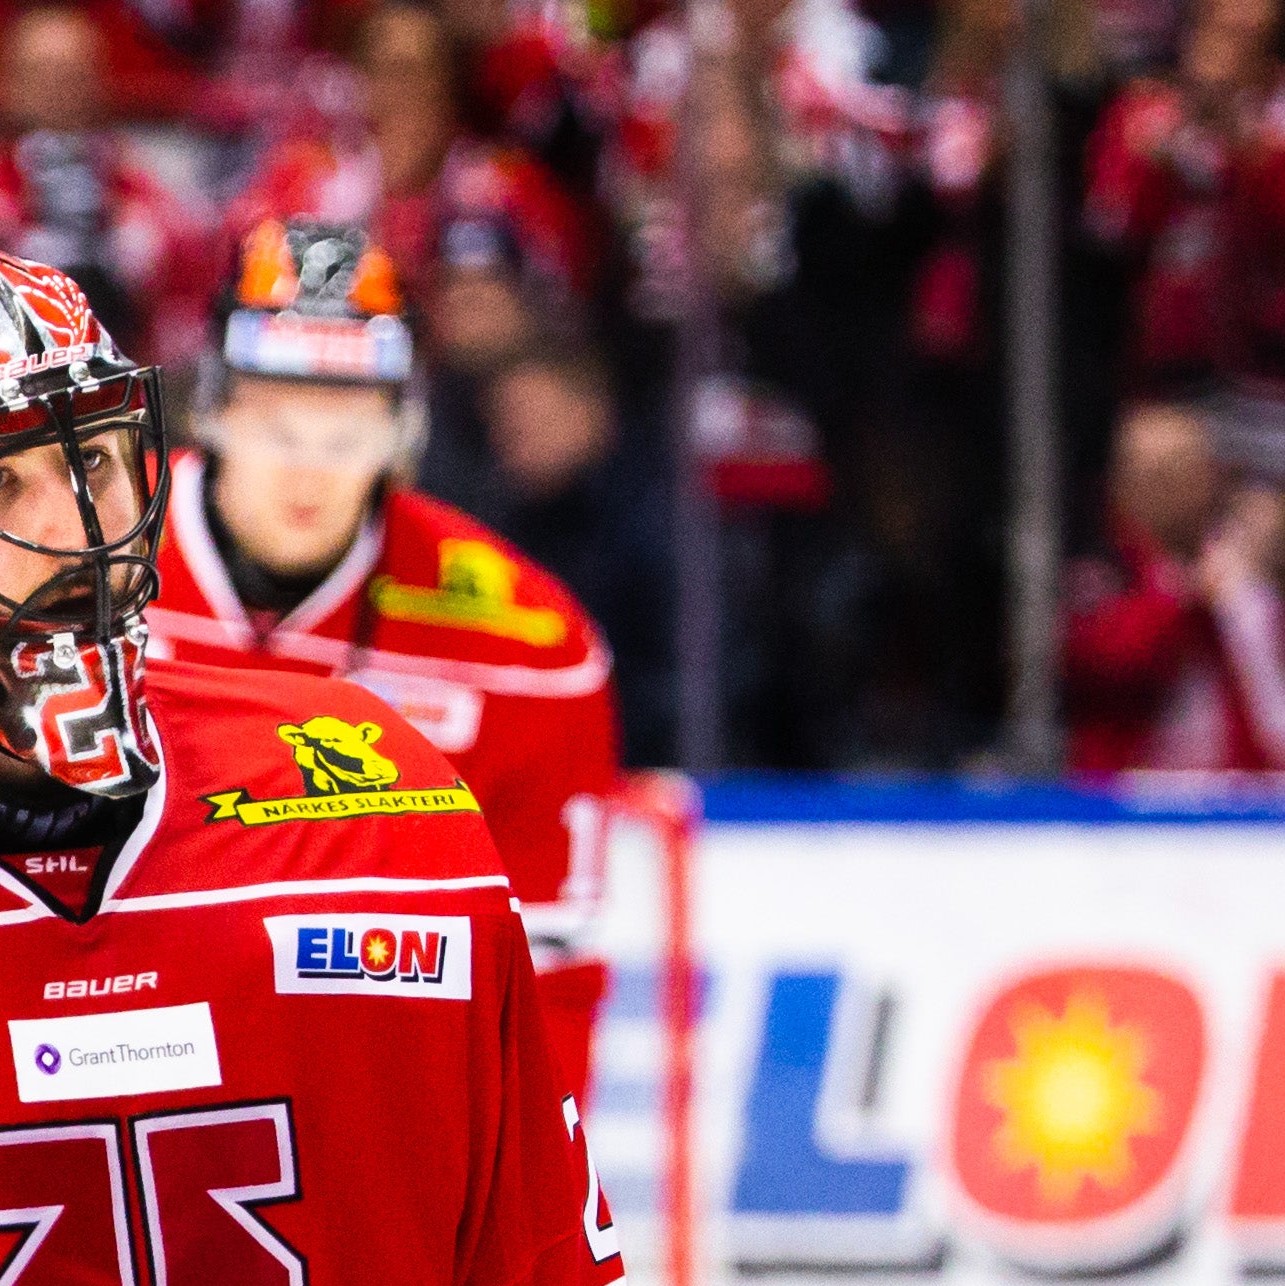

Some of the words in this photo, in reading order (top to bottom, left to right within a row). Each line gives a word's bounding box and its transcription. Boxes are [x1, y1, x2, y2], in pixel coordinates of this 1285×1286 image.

[355, 794, 456, 809] SLAKTERI
[24, 856, 89, 874] SHL
[296, 927, 448, 983] ELON
[43, 971, 159, 1000] BAUER
